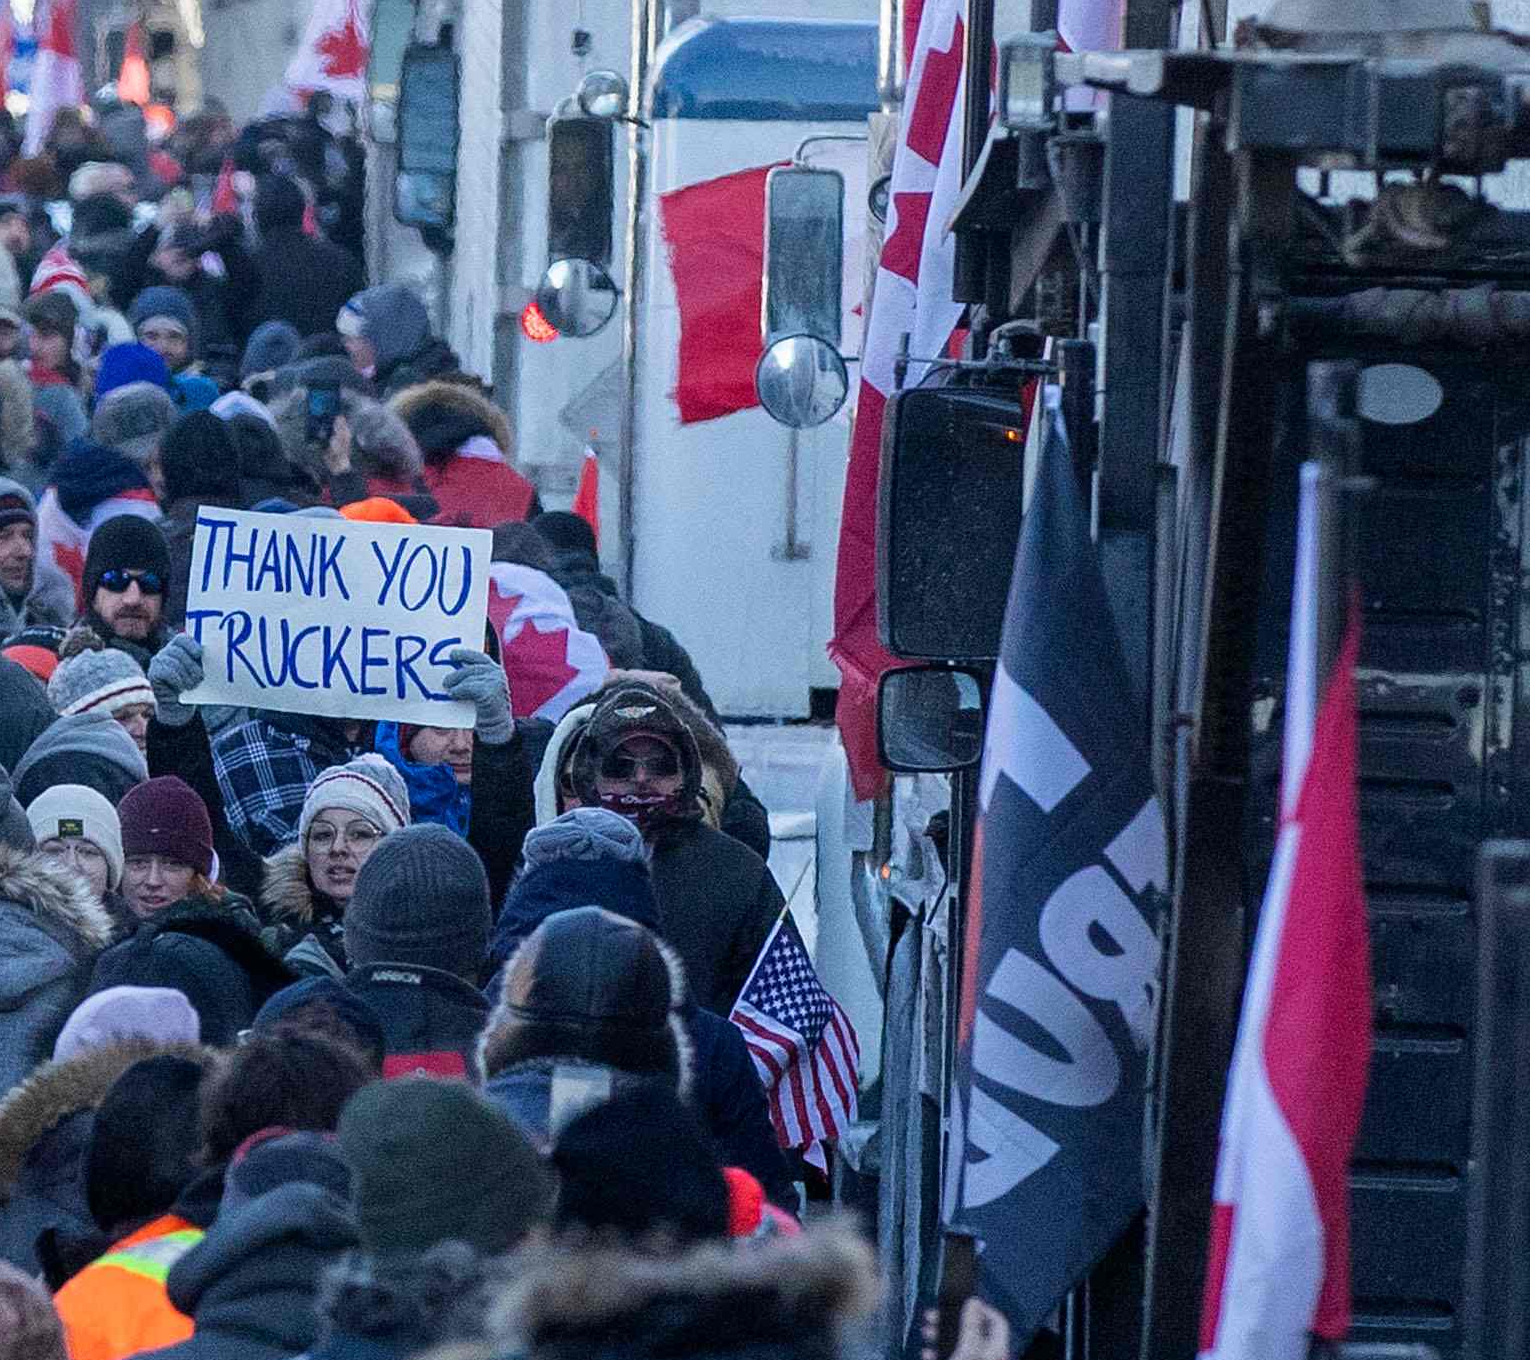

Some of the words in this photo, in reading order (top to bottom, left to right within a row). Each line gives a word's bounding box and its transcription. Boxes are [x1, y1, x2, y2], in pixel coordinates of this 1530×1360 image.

[197, 516, 350, 601] THANK
[372, 537, 472, 617] YOU
[187, 609, 462, 702] TRUCKERS
